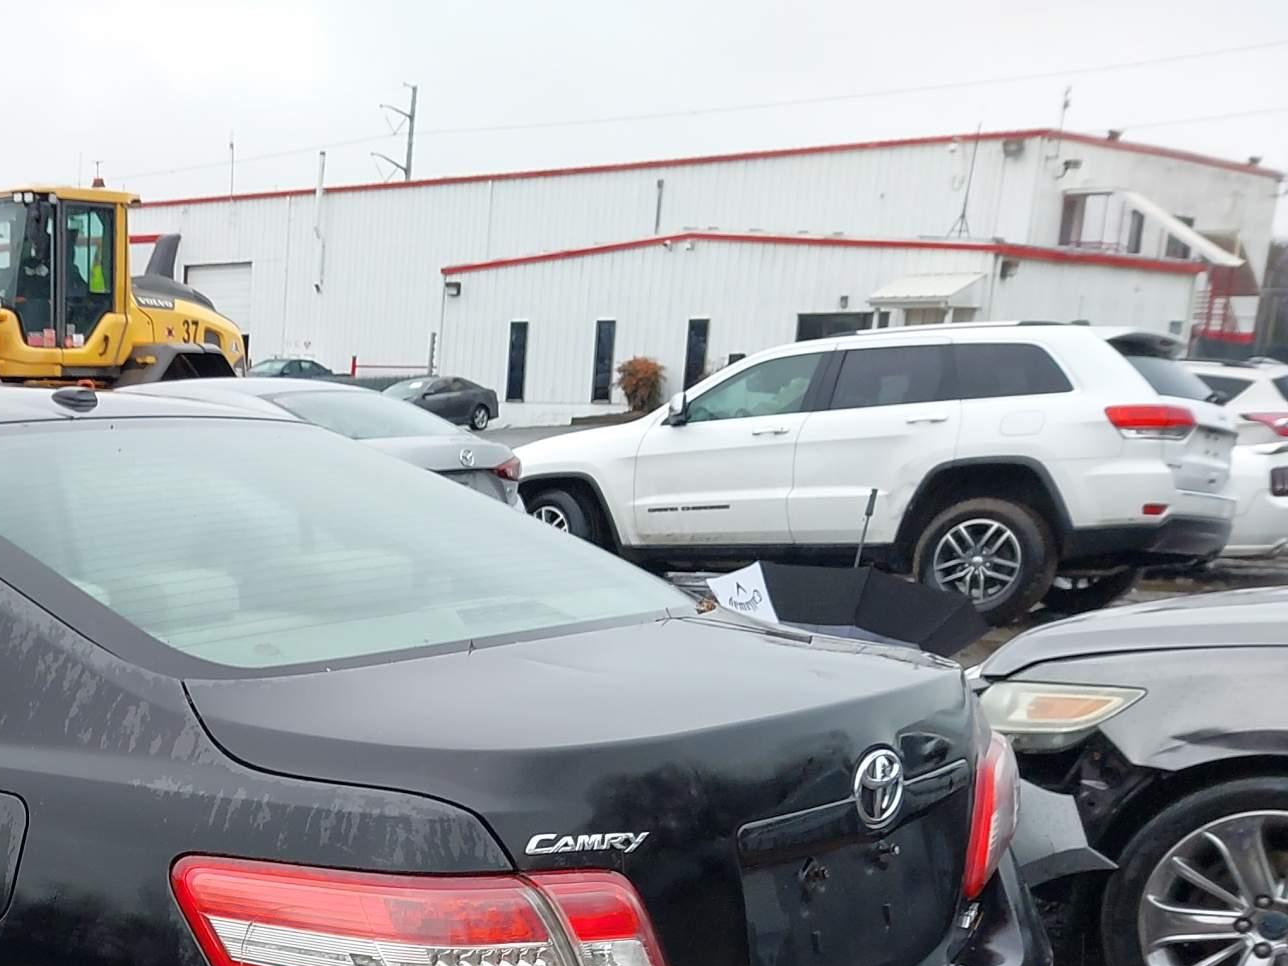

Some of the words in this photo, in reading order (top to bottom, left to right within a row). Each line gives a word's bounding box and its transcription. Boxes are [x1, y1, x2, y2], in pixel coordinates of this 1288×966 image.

[136, 296, 174, 308] VOLVO
[182, 319, 200, 344] 37
[525, 831, 650, 855] CAMRY
